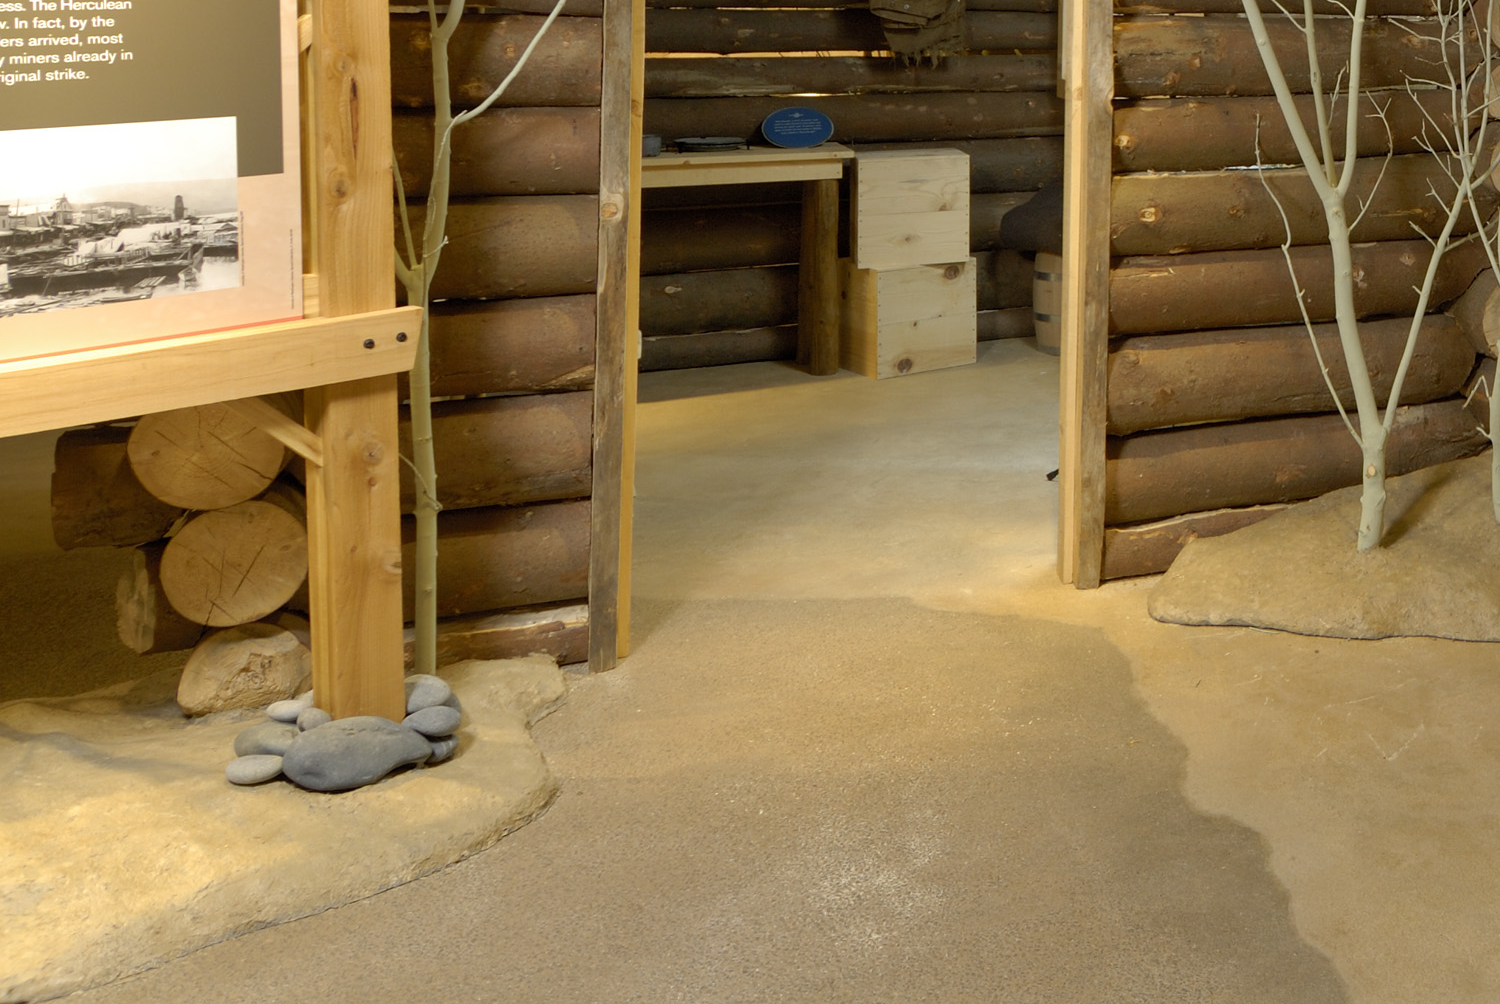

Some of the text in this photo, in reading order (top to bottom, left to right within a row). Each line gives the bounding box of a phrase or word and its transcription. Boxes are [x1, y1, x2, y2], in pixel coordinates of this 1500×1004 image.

[29, 0, 57, 11] The
[14, 17, 28, 29] In
[32, 16, 65, 30] fact,
[69, 16, 87, 31] by
[91, 15, 115, 27] the
[28, 33, 83, 46] arrived,
[87, 33, 123, 44] most
[9, 52, 60, 64] miners
[63, 49, 117, 64] already
[120, 49, 133, 60] in
[45, 68, 90, 81] strike.
